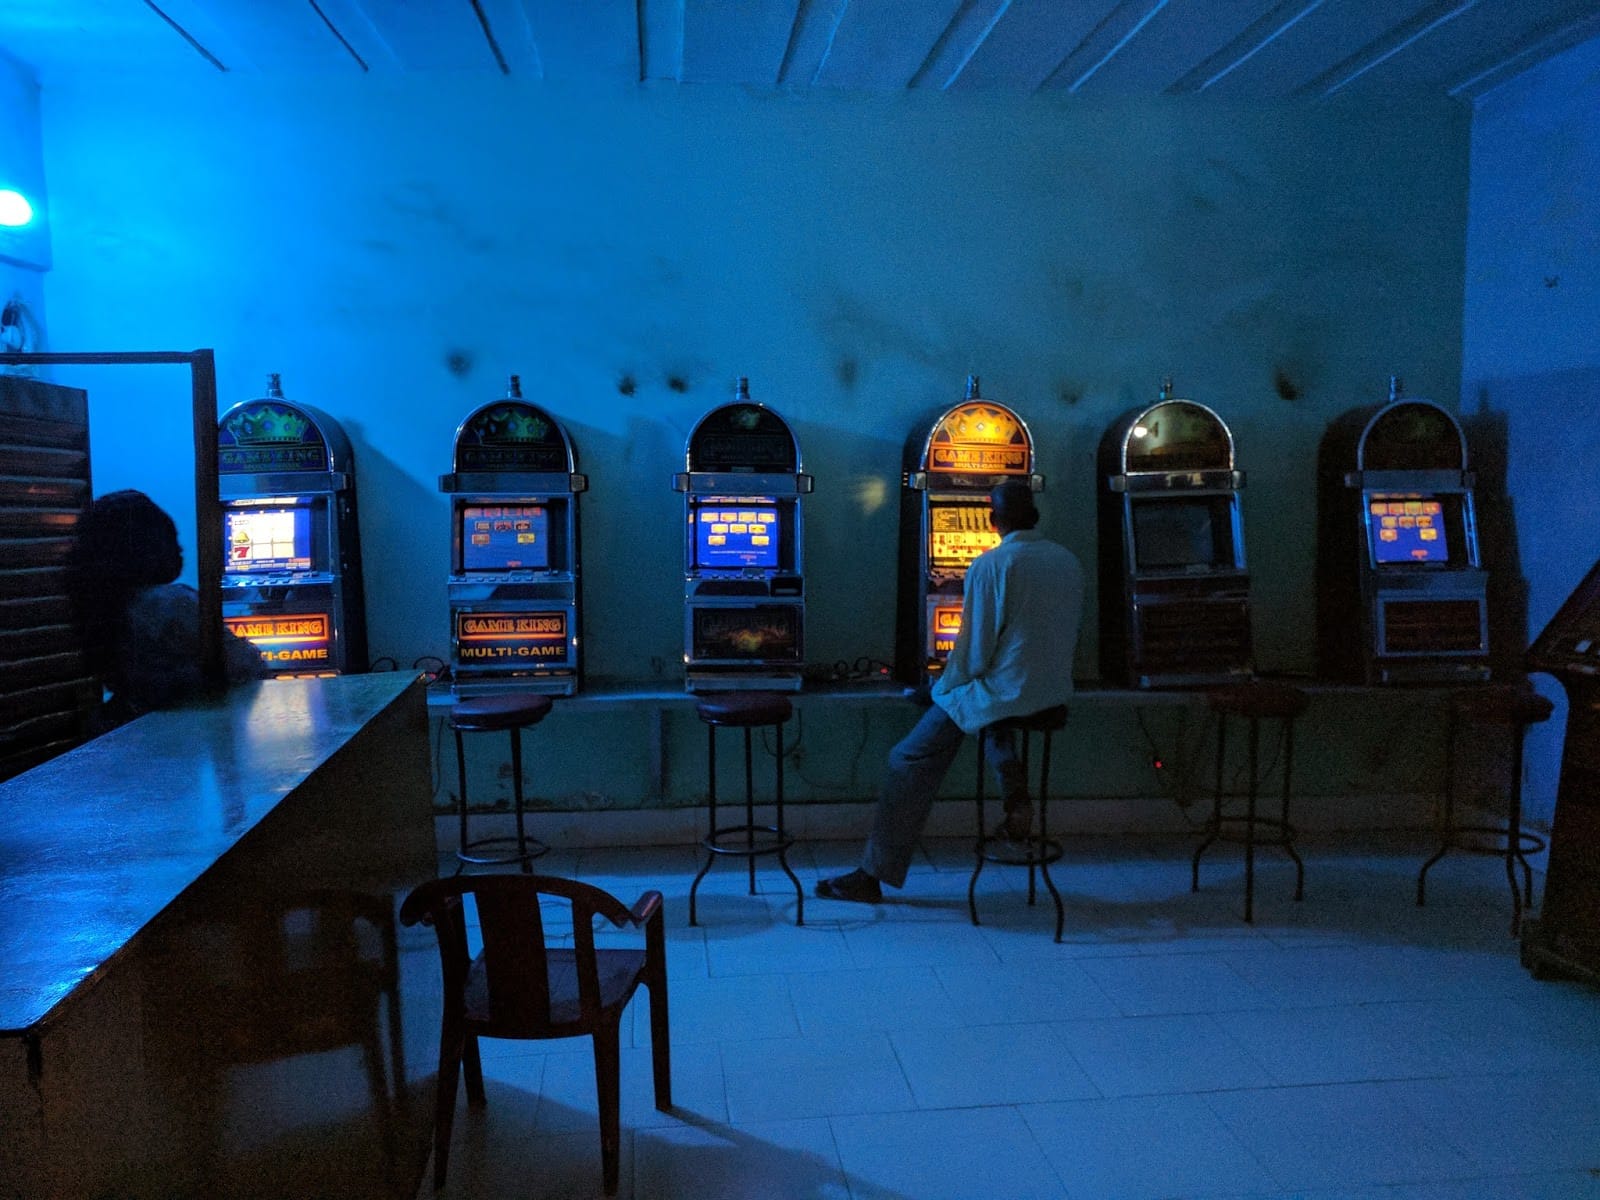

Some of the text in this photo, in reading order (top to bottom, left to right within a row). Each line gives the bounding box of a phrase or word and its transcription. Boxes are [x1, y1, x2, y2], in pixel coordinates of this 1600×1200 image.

[935, 450, 1023, 464] GAME KING
[276, 620, 322, 635] KING
[464, 618, 561, 633] GAME KING
[461, 646, 566, 657] MULTI-GAME
